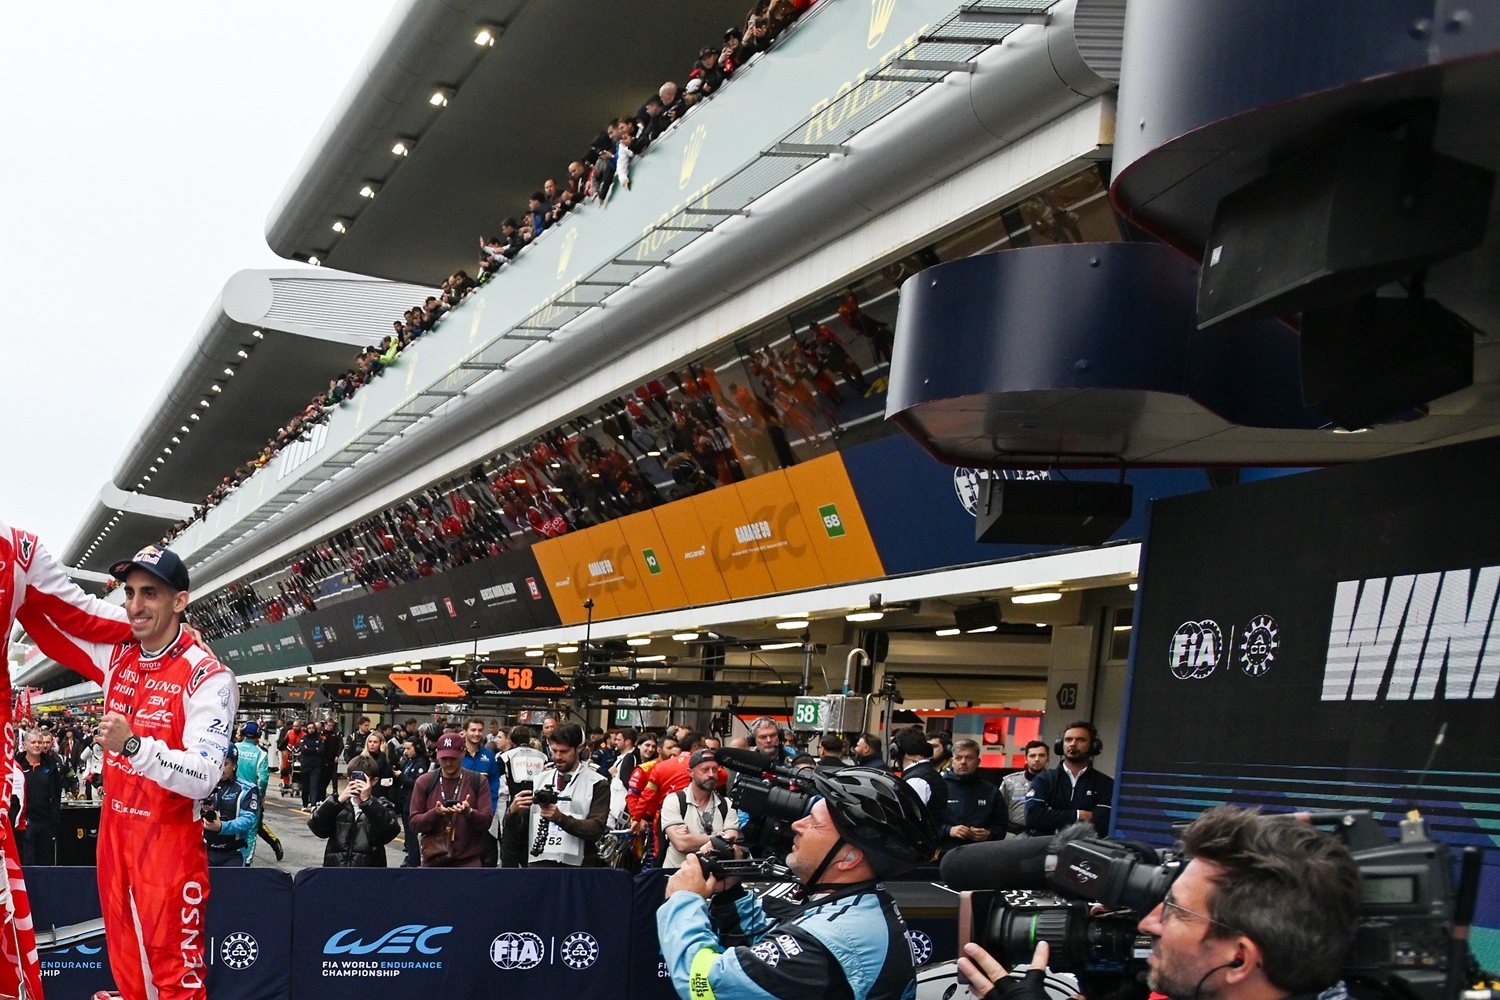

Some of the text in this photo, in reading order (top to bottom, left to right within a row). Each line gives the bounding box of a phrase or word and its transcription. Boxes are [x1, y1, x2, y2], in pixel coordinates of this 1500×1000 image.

[804, 23, 929, 145] ROLEX
[823, 513, 841, 529] 58
[734, 521, 772, 544] GARAGE 59
[647, 554, 657, 568] 10
[1320, 565, 1500, 701] WIN
[417, 676, 433, 693] 10
[507, 668, 533, 690] 58
[599, 682, 640, 691] McLaren
[145, 680, 182, 694] DENSO
[354, 687, 369, 698] 19
[534, 684, 570, 692] McLaren
[1059, 687, 1077, 706] 03
[136, 709, 174, 723] WEC
[796, 704, 815, 723] 58
[515, 761, 526, 769] PIT
[186, 768, 208, 781] MILLE
[548, 836, 562, 846] 52
[180, 880, 204, 989] DENSO
[323, 924, 453, 955] WEC
[231, 942, 248, 957] ACO
[495, 939, 539, 962] FIA
[571, 942, 588, 957] ACO
[779, 934, 800, 957] OMP
[41, 961, 102, 969] ENDURANCE
[322, 961, 442, 969] FIA WORLD ENDURANCE
[322, 969, 401, 978] CHAMPIONSHIP
